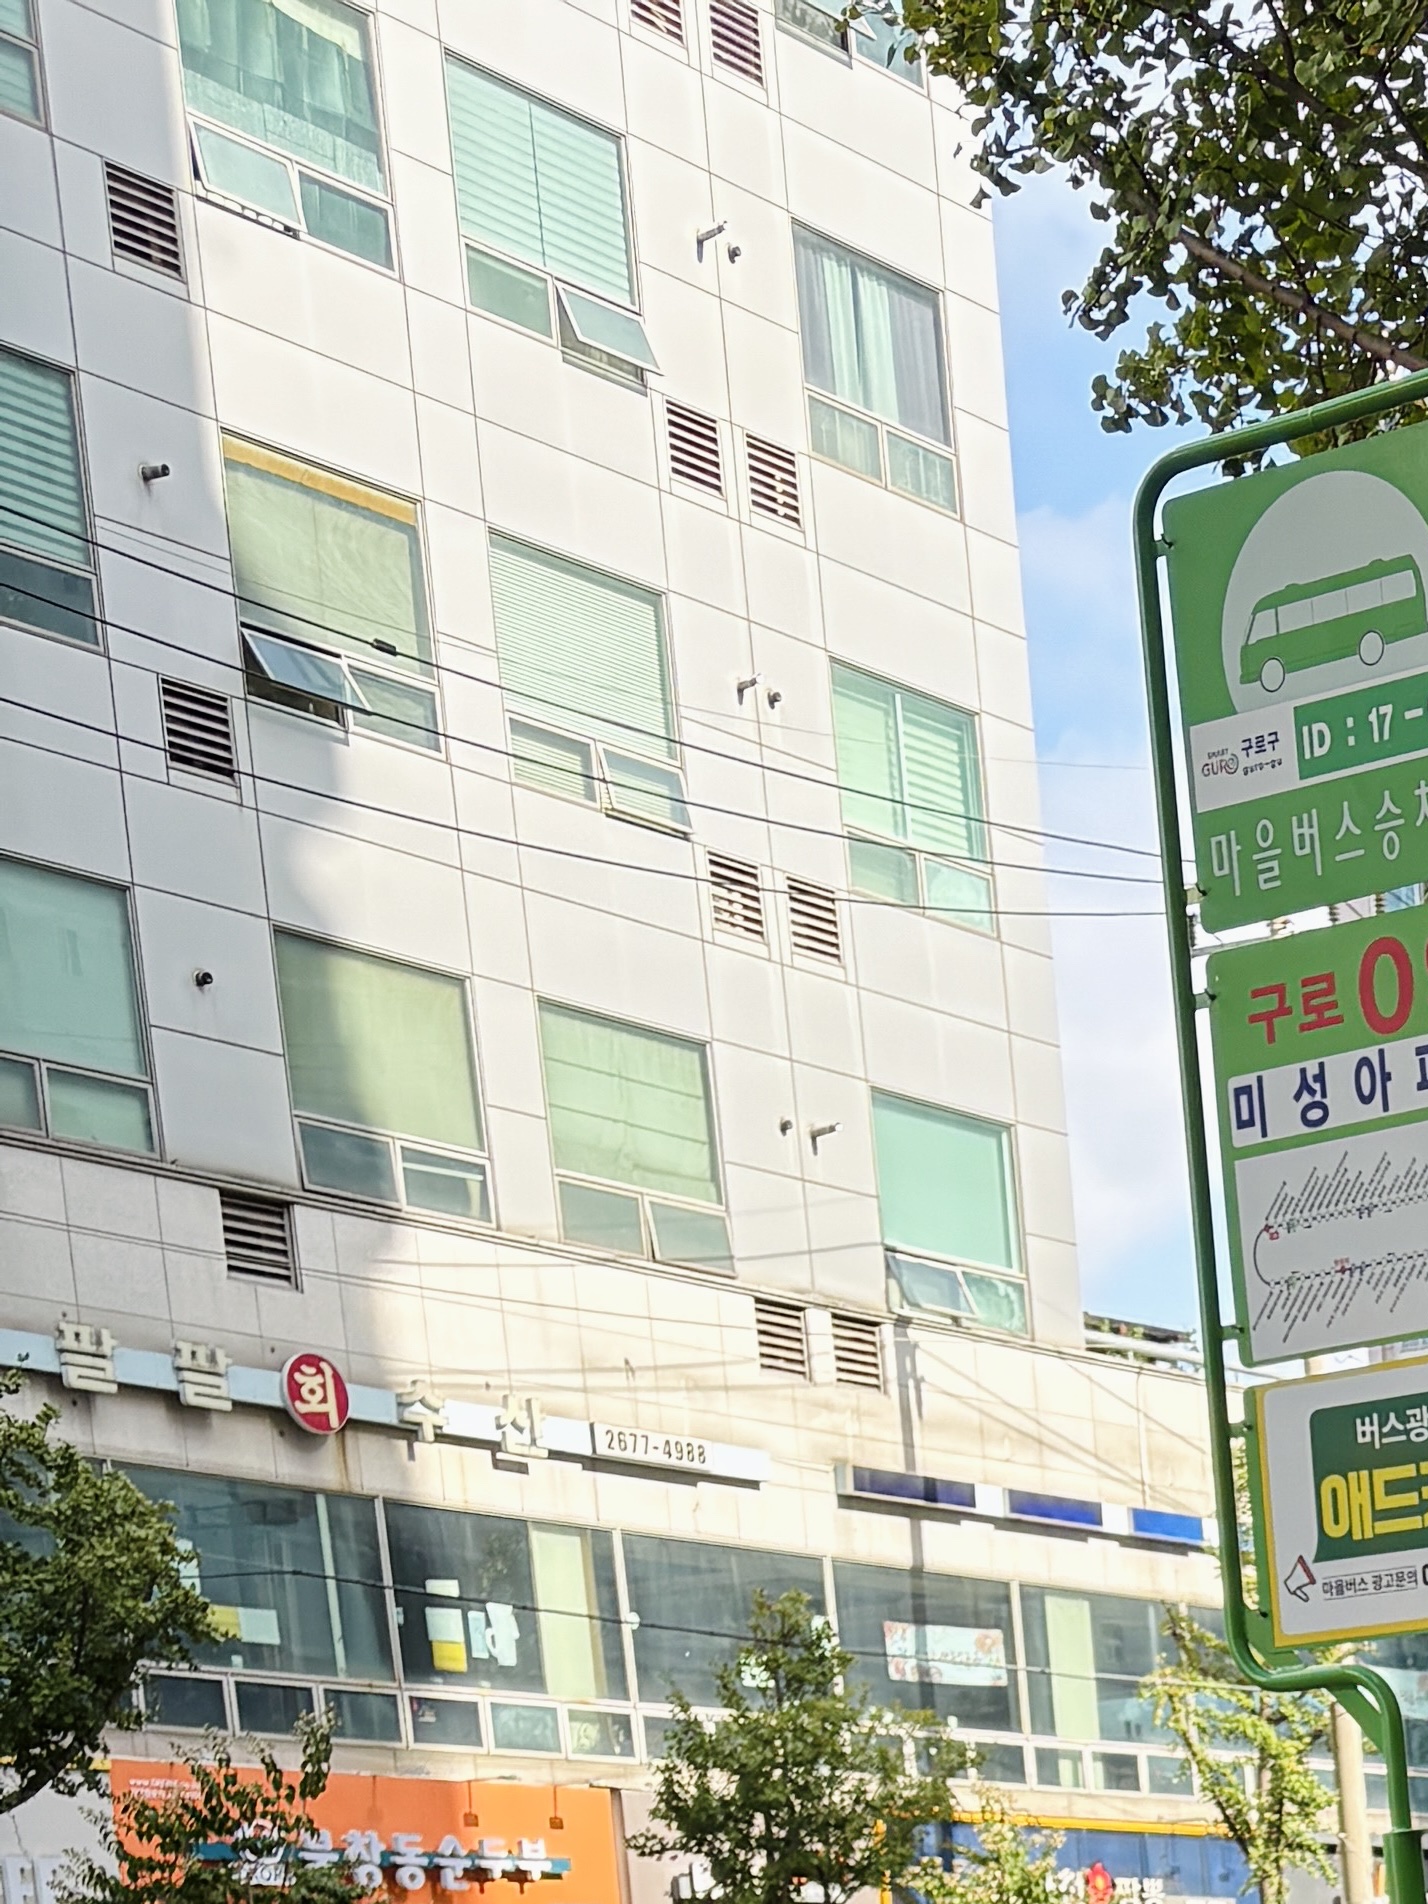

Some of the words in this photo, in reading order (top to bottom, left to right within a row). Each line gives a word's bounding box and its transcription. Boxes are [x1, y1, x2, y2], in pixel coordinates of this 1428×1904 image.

[1301, 716, 1332, 760] ID
[1201, 753, 1239, 777] GURO
[1247, 969, 1345, 1045] 구로
[604, 1428, 707, 1464] 2677-4988
[1322, 1577, 1369, 1598] 마을버스
[1371, 1569, 1418, 1592] 광고문의
